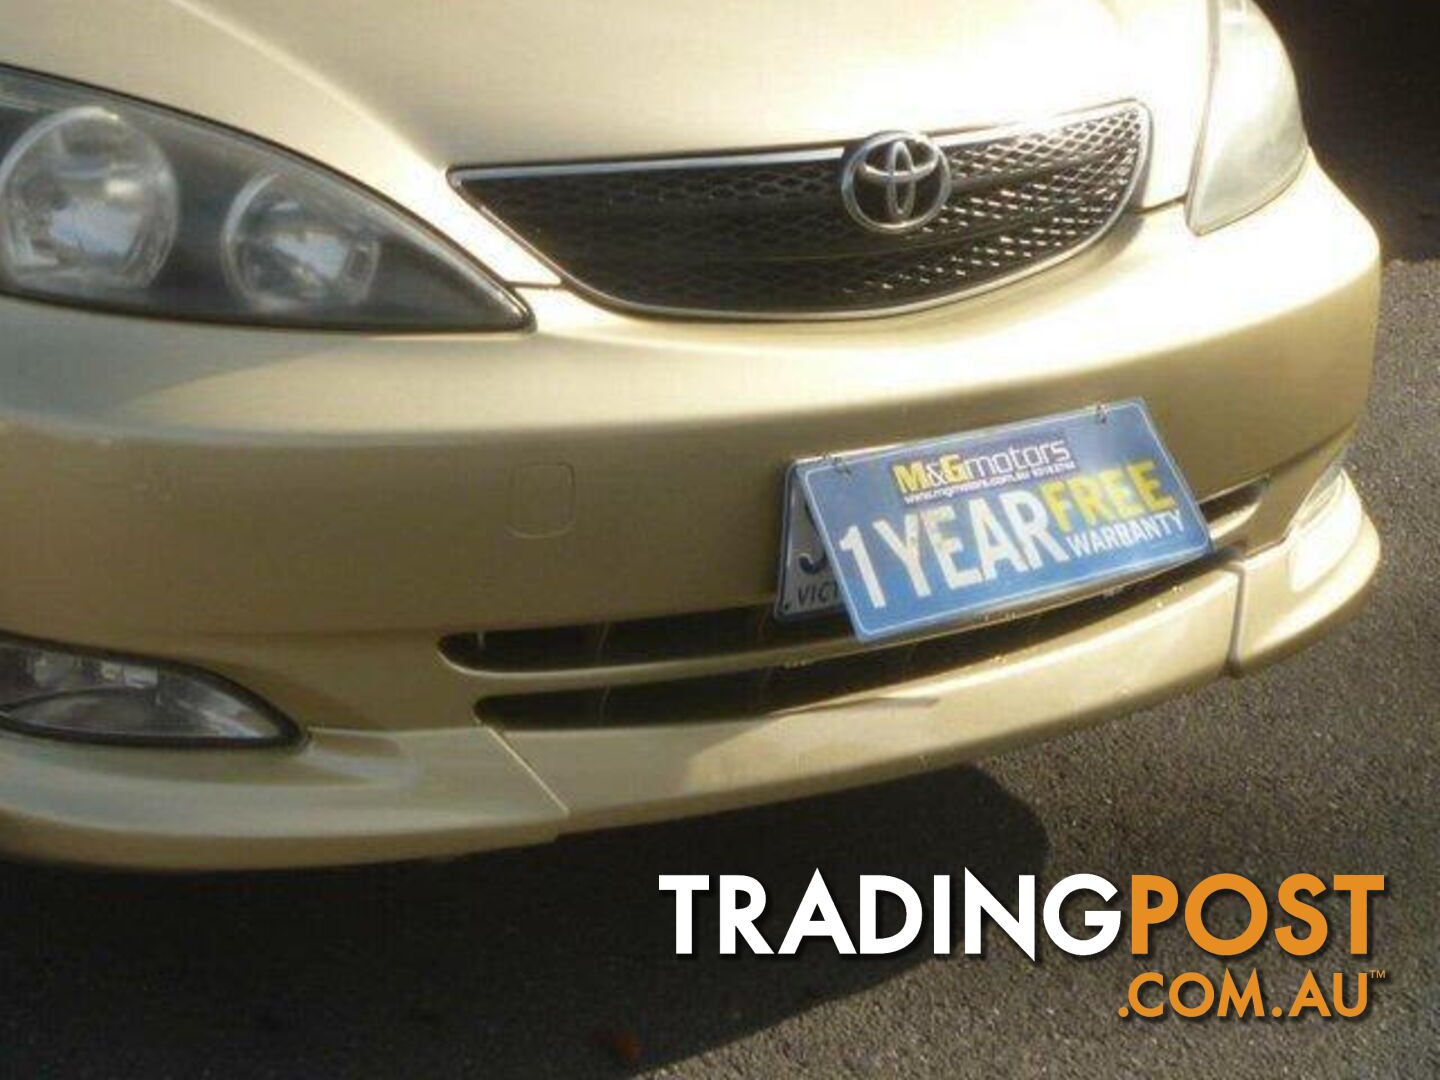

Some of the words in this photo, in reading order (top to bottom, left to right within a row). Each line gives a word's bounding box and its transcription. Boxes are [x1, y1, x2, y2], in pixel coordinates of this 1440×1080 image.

[873, 490, 1070, 599] YEAR
[1038, 459, 1177, 532] FREE
[1065, 508, 1186, 558] WARRANTY
